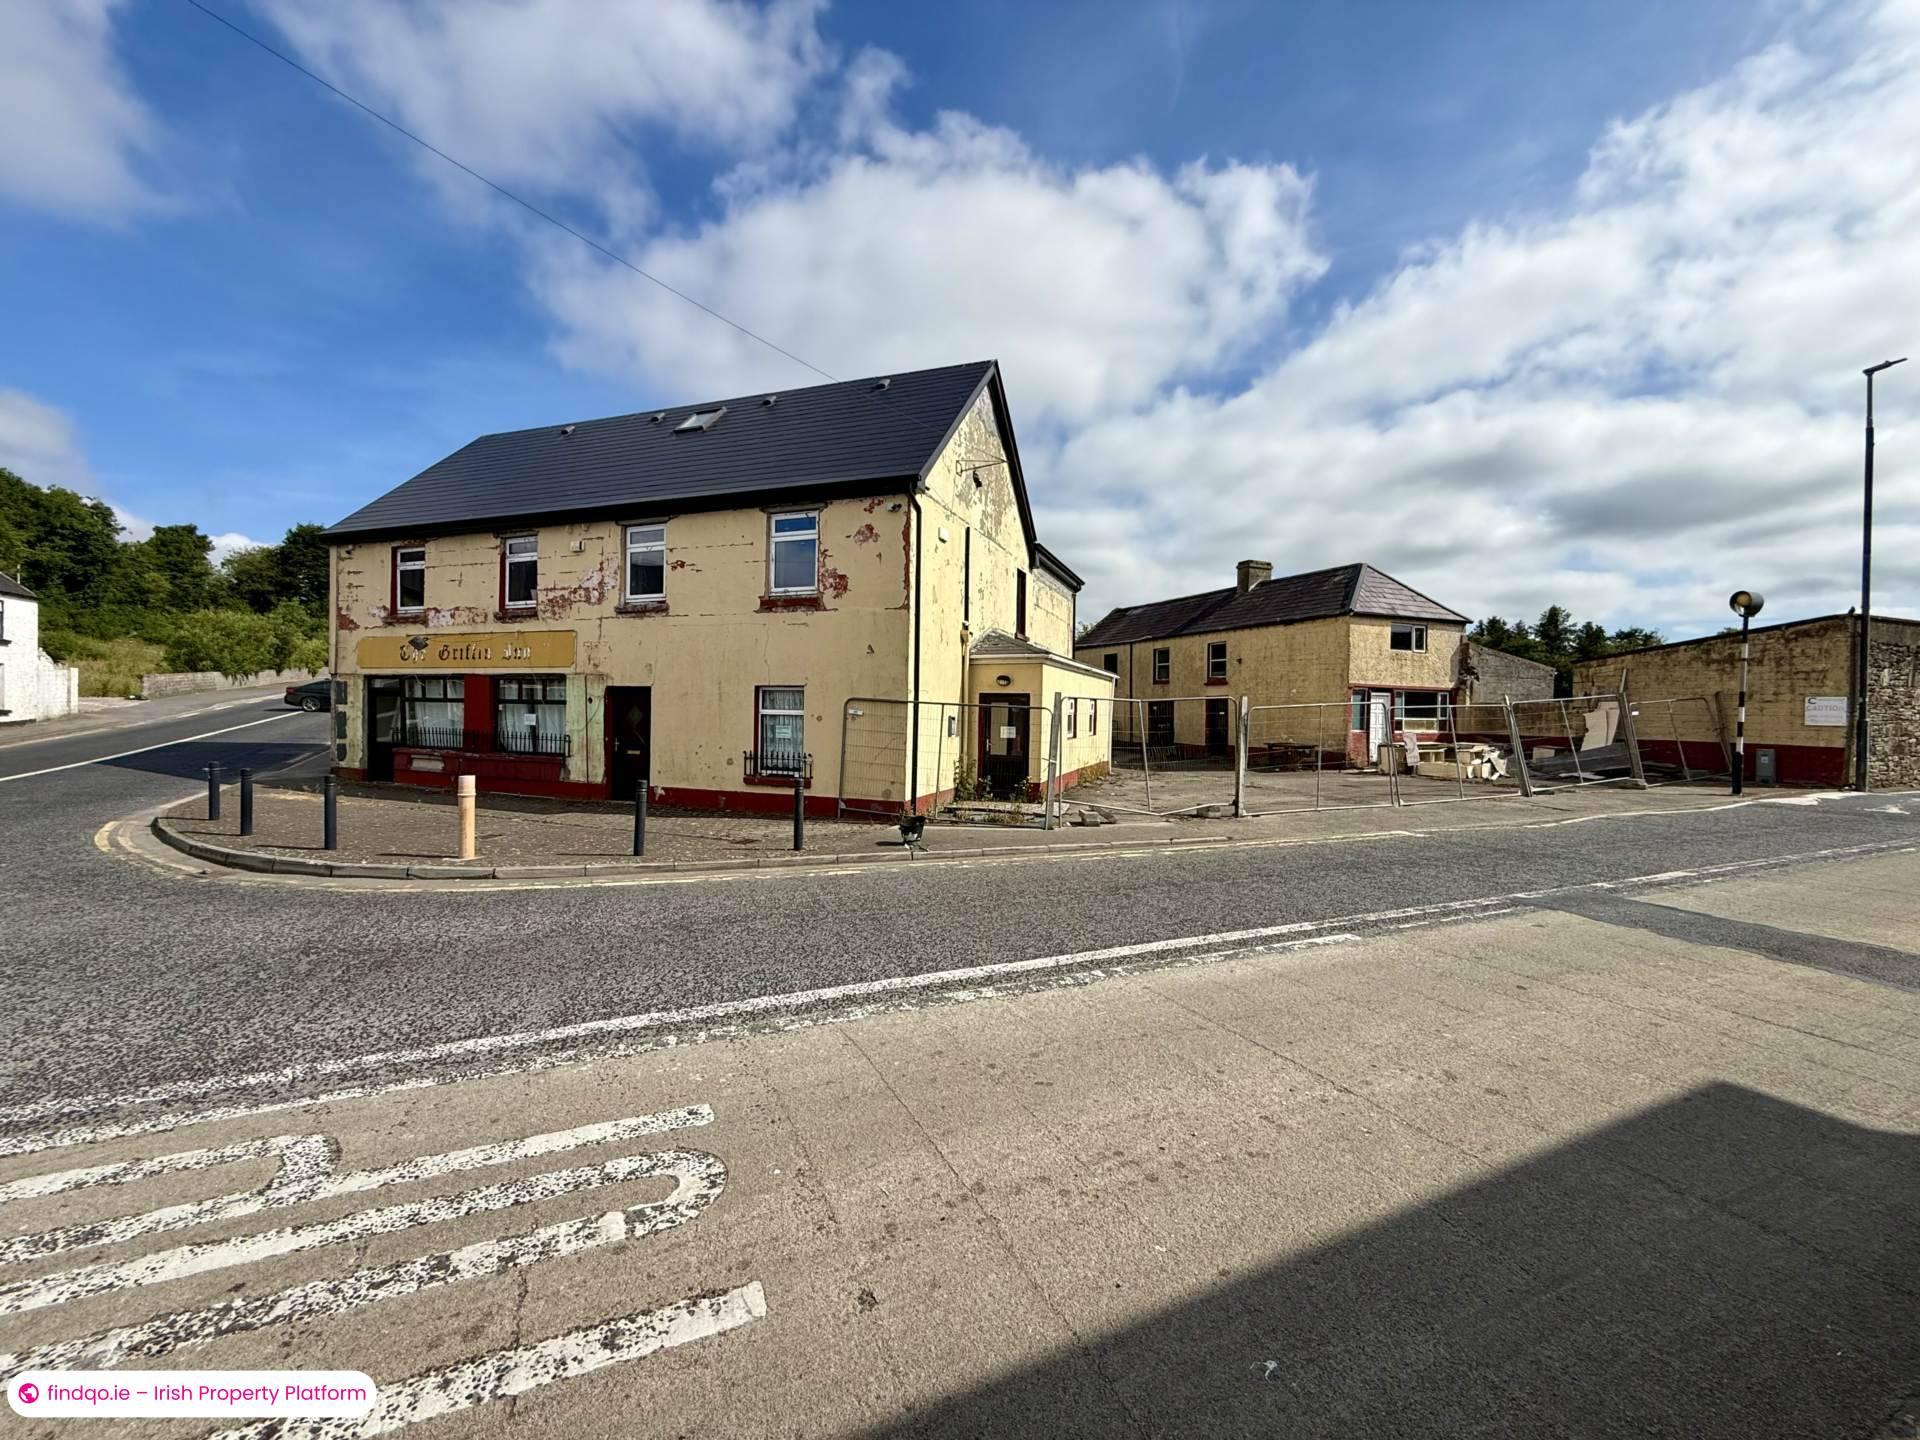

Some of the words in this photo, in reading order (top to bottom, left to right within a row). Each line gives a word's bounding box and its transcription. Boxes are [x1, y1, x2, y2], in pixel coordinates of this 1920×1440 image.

[399, 643, 426, 663] The
[438, 643, 491, 661] Griffin
[502, 642, 532, 661] Inn
